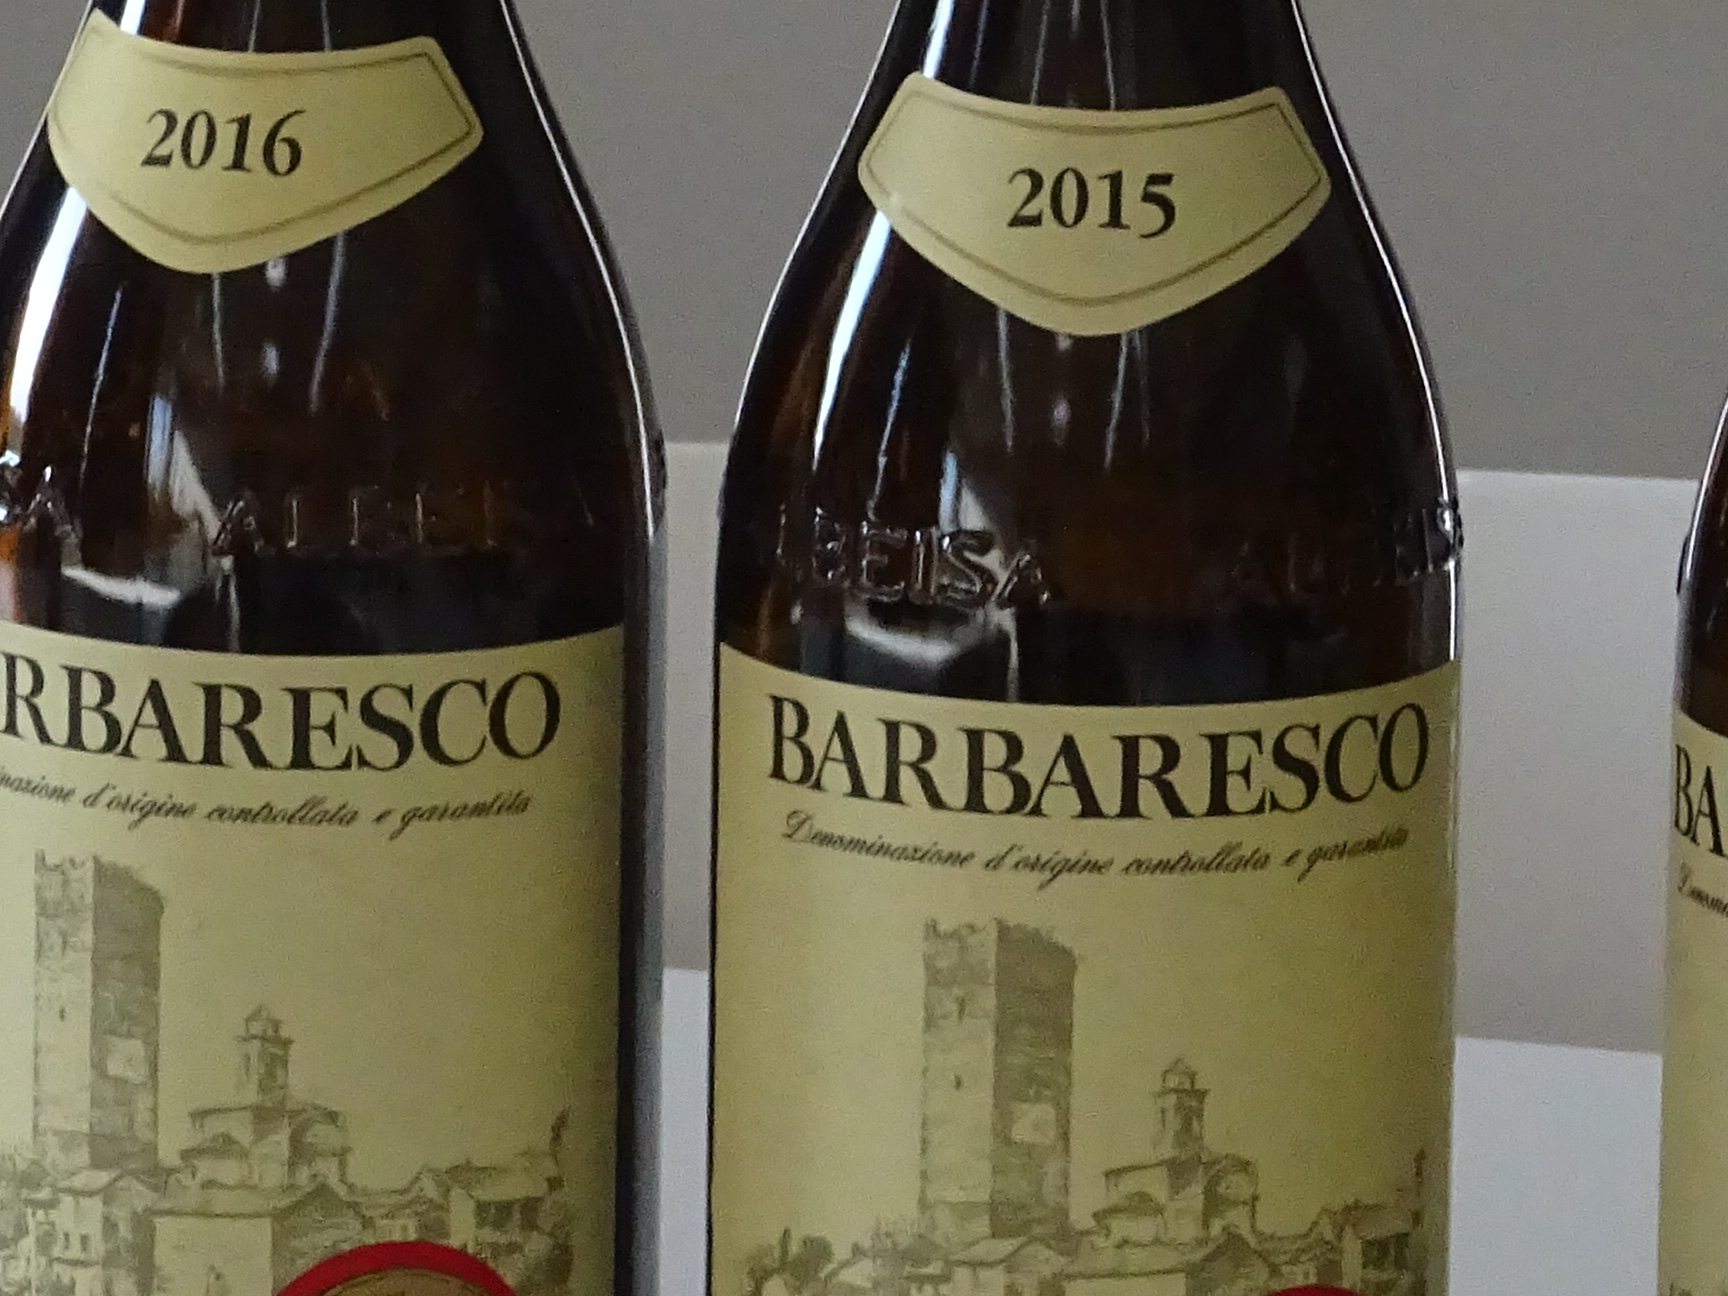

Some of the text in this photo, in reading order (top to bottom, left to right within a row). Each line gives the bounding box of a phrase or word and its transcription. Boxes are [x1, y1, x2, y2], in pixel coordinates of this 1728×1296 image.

[139, 107, 308, 178] 2016
[1006, 166, 1177, 239] 2015
[764, 692, 1430, 821] BARBARESCO
[82, 781, 199, 833] d'origine
[203, 795, 361, 827] controllata
[387, 788, 534, 842] garantita
[781, 809, 978, 870] Denominazione
[982, 842, 1115, 891] d'origine
